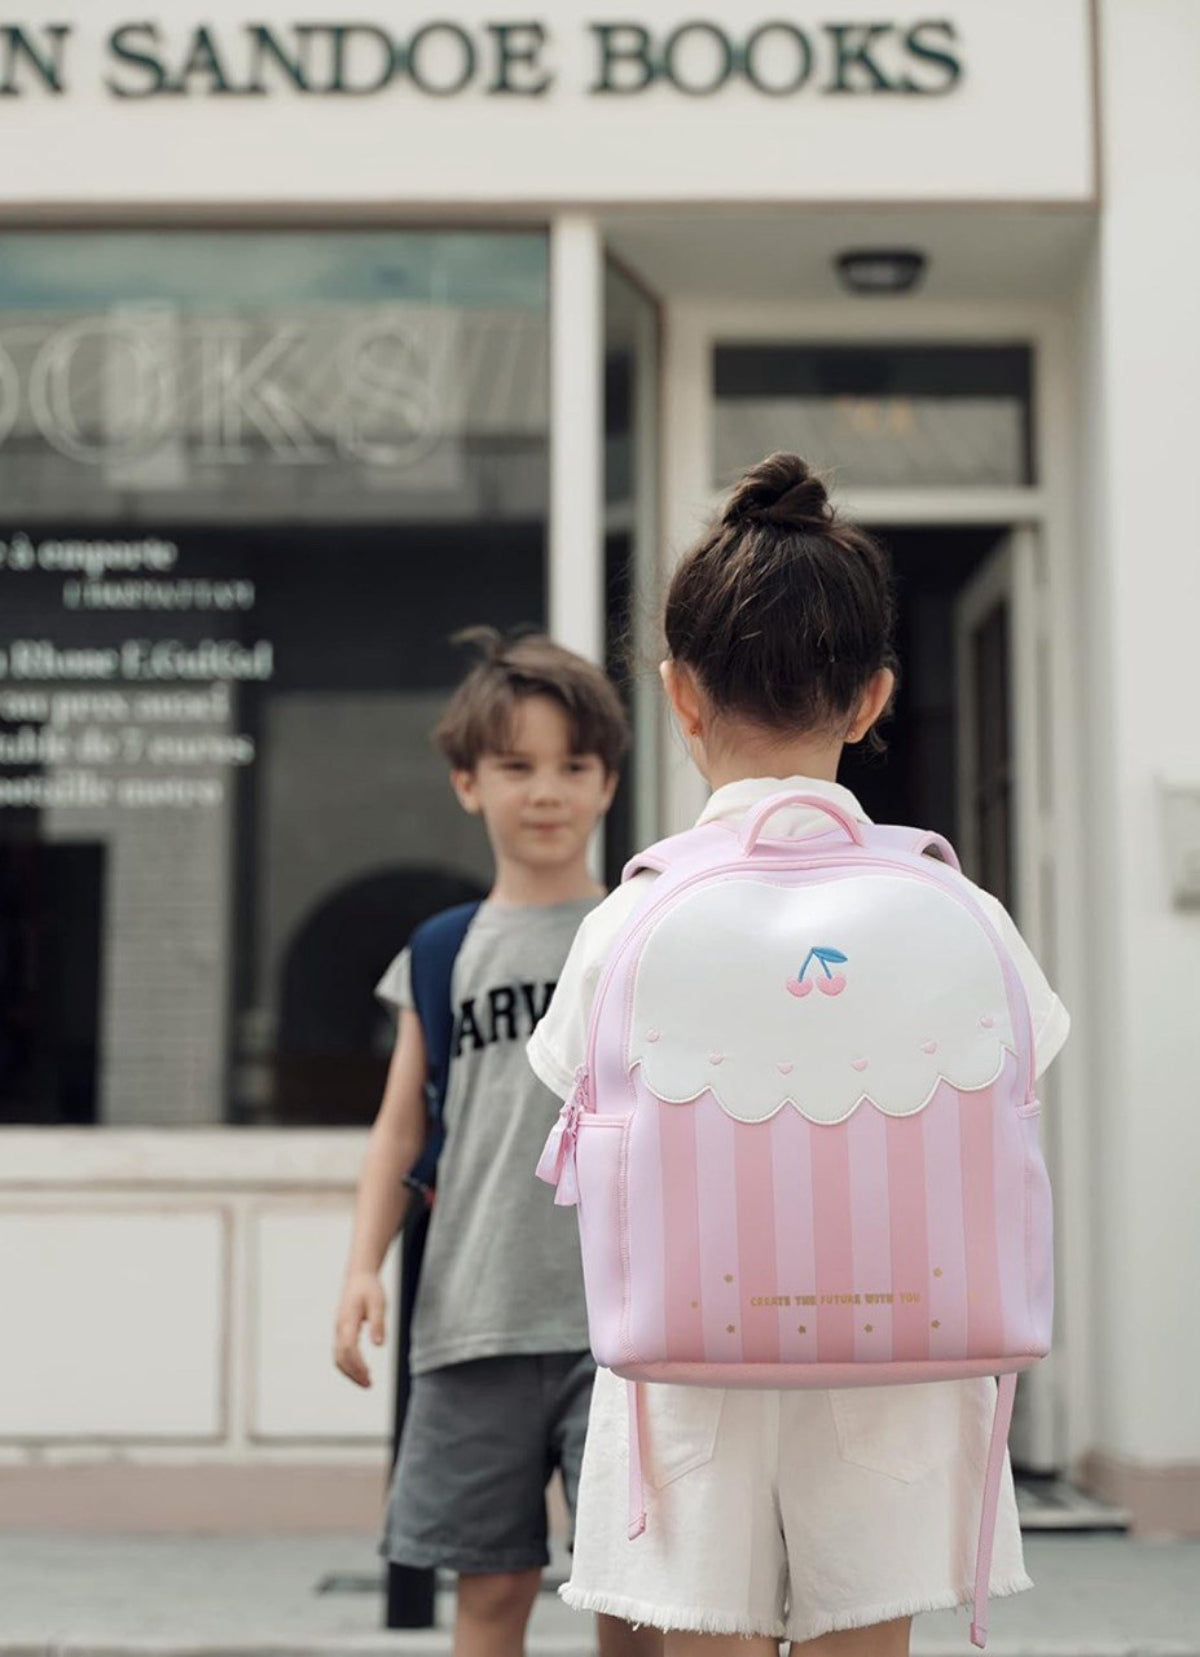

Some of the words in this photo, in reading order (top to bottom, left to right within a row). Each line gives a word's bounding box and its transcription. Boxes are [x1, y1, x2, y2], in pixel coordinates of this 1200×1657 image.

[106, 20, 555, 98] SANDOE
[589, 20, 963, 98] BOOKS
[751, 1295, 790, 1306] CREATE
[795, 1295, 816, 1306] THE
[821, 1294, 861, 1305] FUTURE
[866, 1293, 894, 1305] WITH
[900, 1293, 921, 1304] YOU
